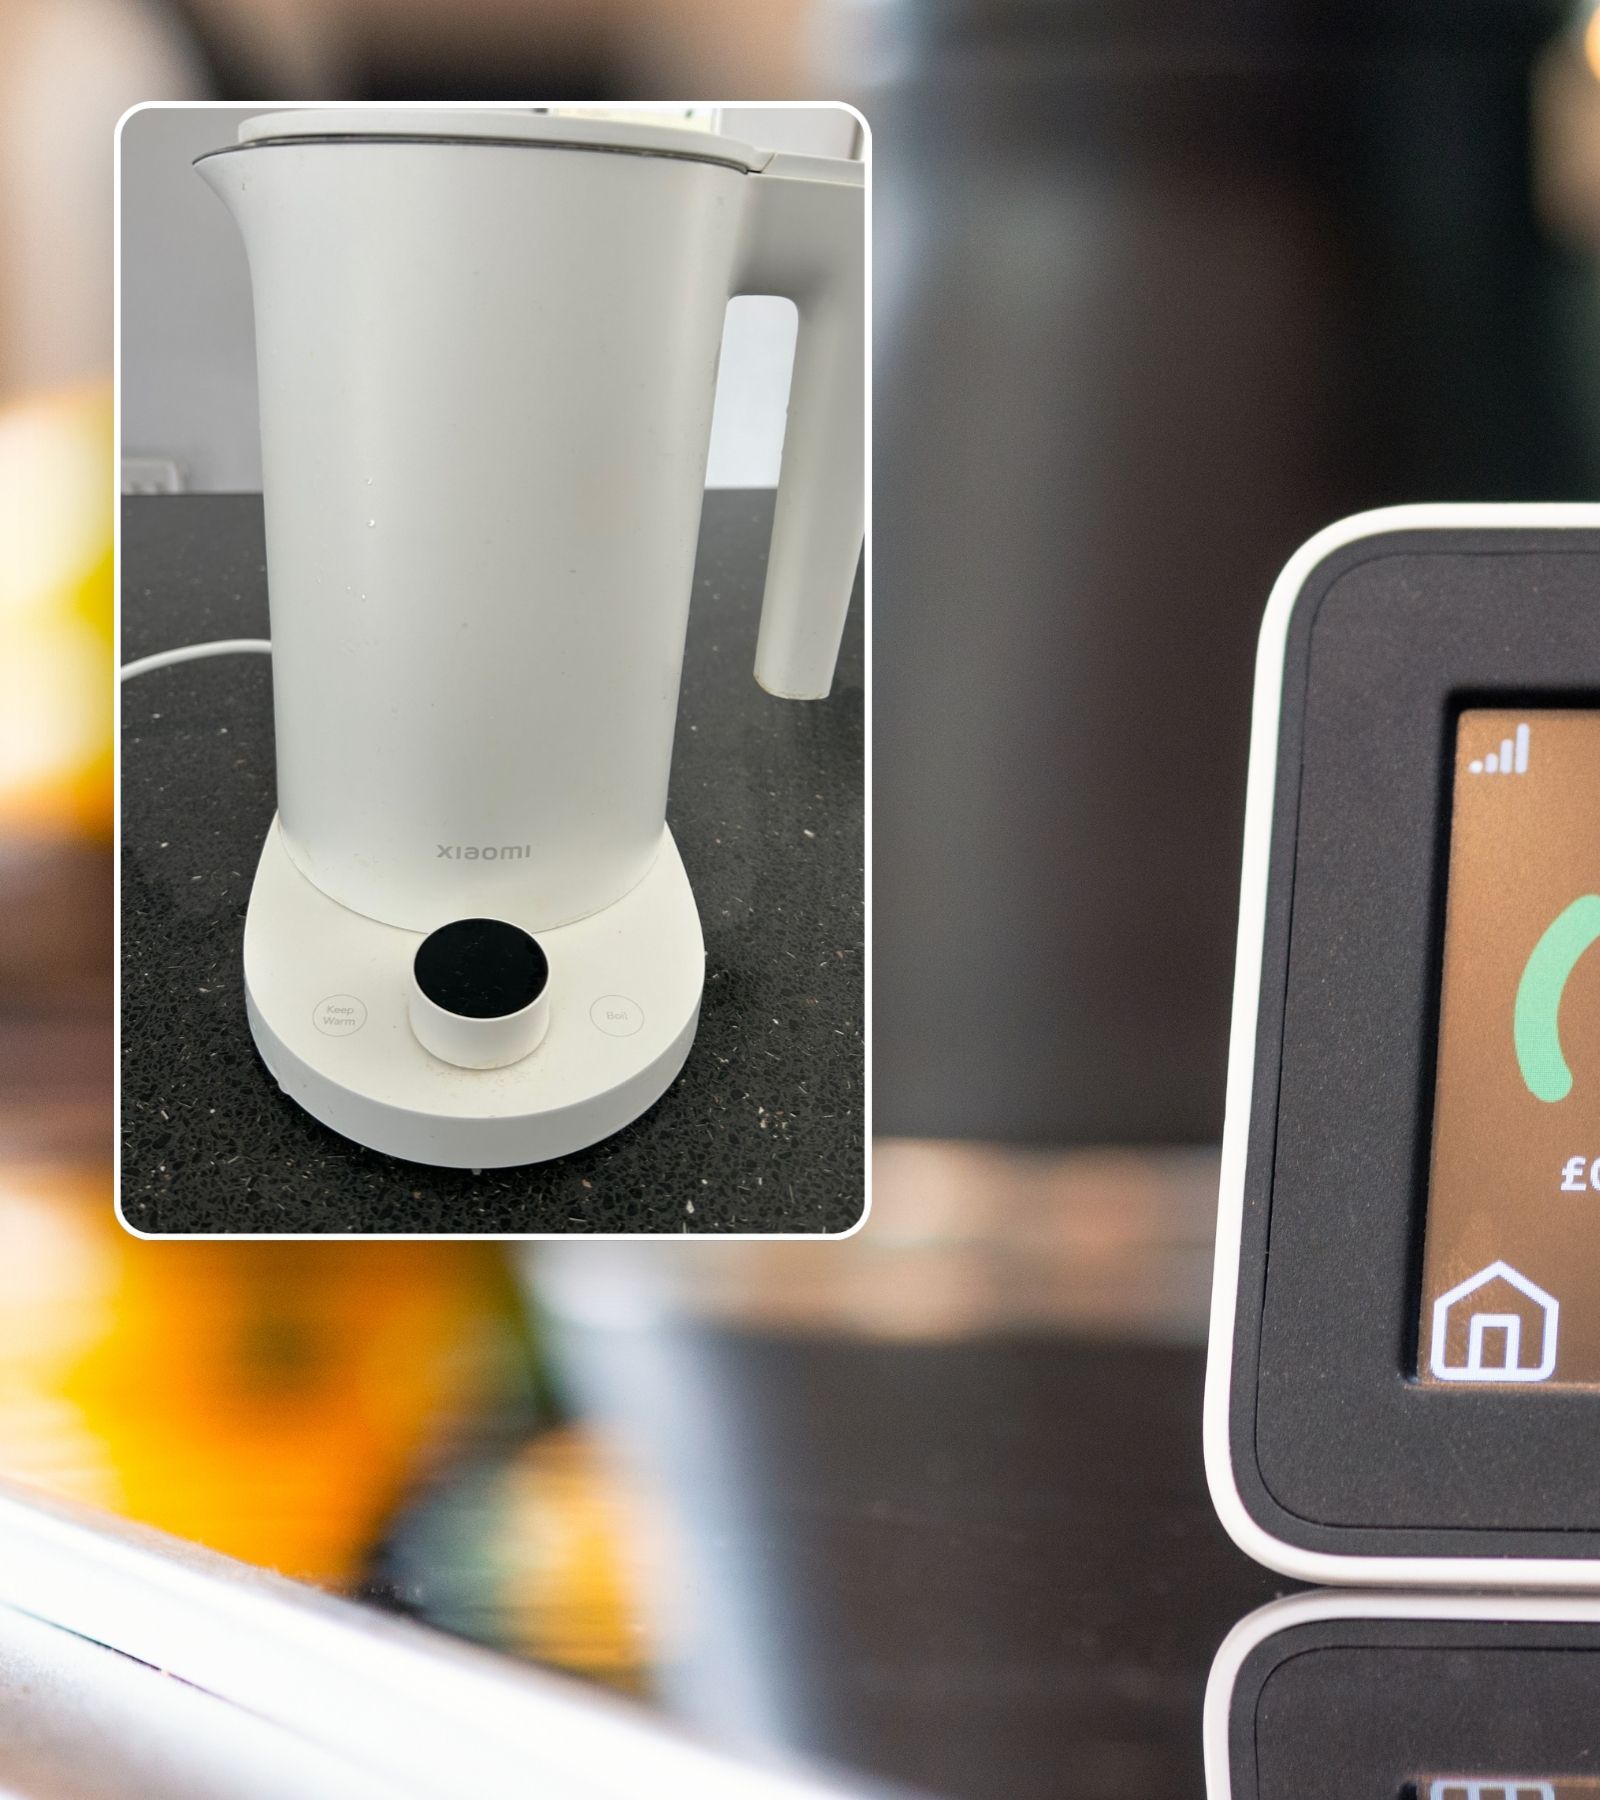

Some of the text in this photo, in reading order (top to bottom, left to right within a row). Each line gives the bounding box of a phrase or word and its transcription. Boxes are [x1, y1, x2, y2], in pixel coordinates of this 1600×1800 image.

[436, 844, 531, 860] xiaomi
[326, 1005, 354, 1016] Keep
[323, 1016, 356, 1025] Warm
